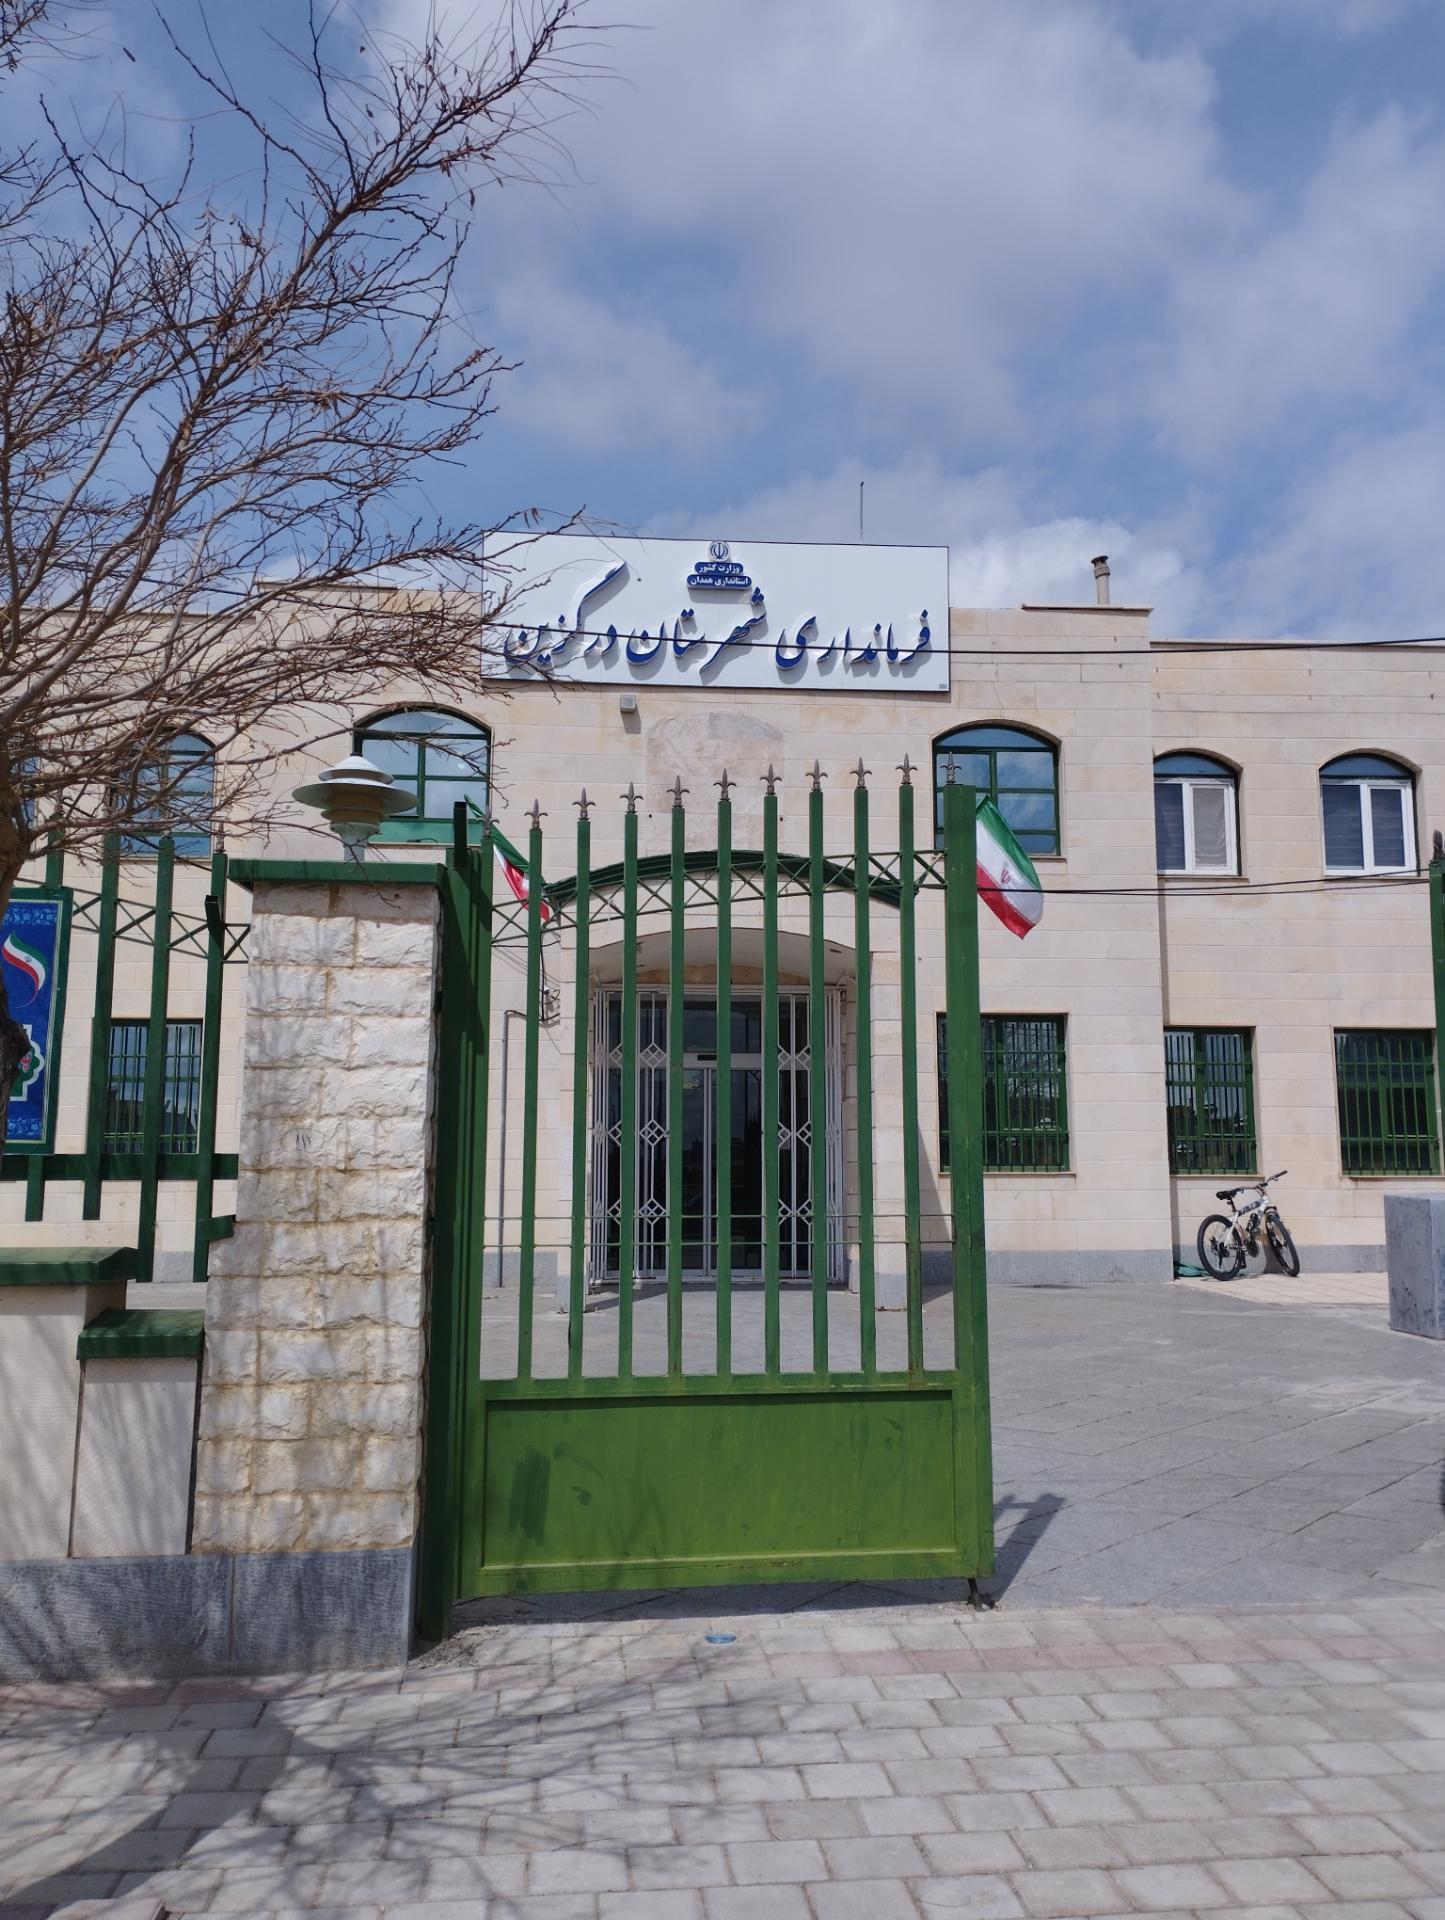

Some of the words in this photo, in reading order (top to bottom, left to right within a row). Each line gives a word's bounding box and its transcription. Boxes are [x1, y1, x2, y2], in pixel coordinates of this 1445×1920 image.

[699, 563, 717, 573] کشور
[719, 563, 740, 574] وزارت
[690, 575, 713, 586] همدان
[715, 576, 748, 587] استانداری
[626, 586, 767, 674] شهرستان
[775, 609, 931, 671] فرمانداری
